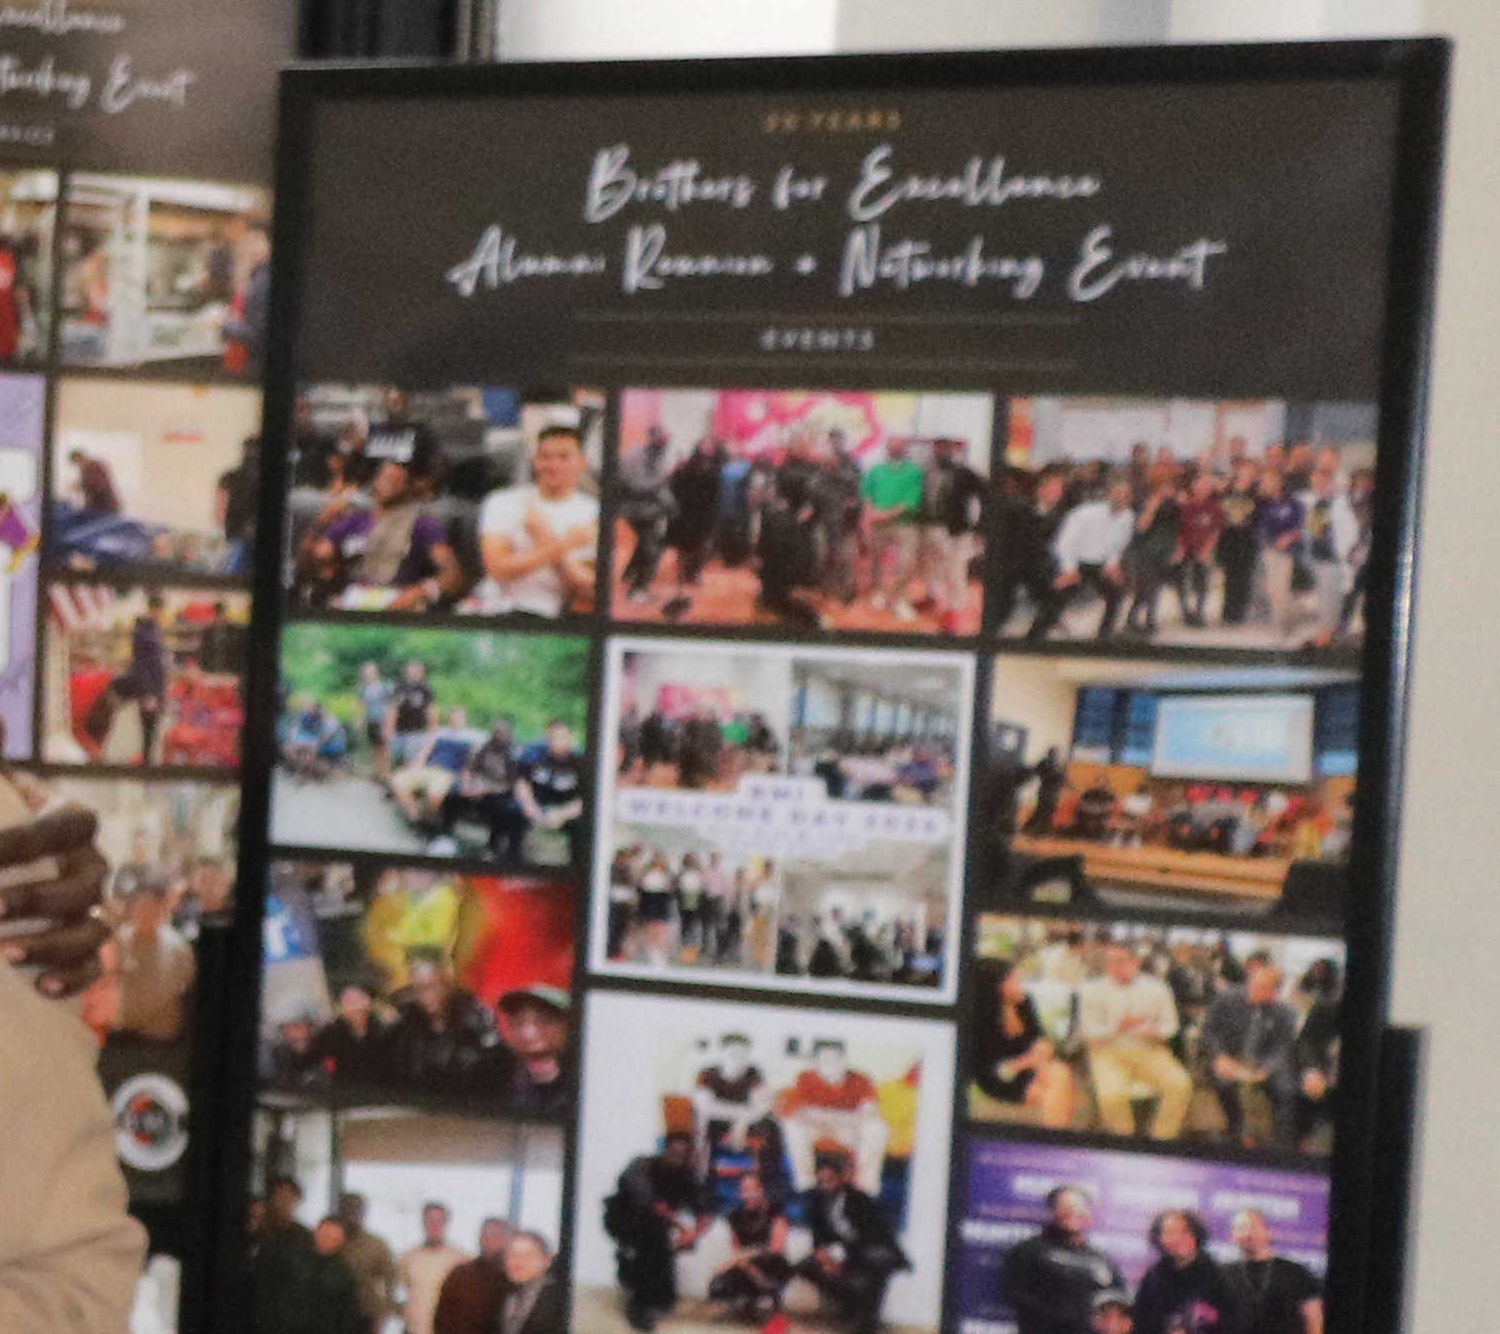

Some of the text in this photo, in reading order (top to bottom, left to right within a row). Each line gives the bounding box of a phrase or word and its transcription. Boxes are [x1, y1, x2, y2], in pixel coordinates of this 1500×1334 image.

[102, 53, 198, 114] Event
[584, 142, 1102, 223] Brothers for Excellence
[446, 225, 606, 298] Alumni
[838, 221, 1046, 299] Networking
[1068, 223, 1229, 302] Event
[759, 326, 875, 354] EVENTS
